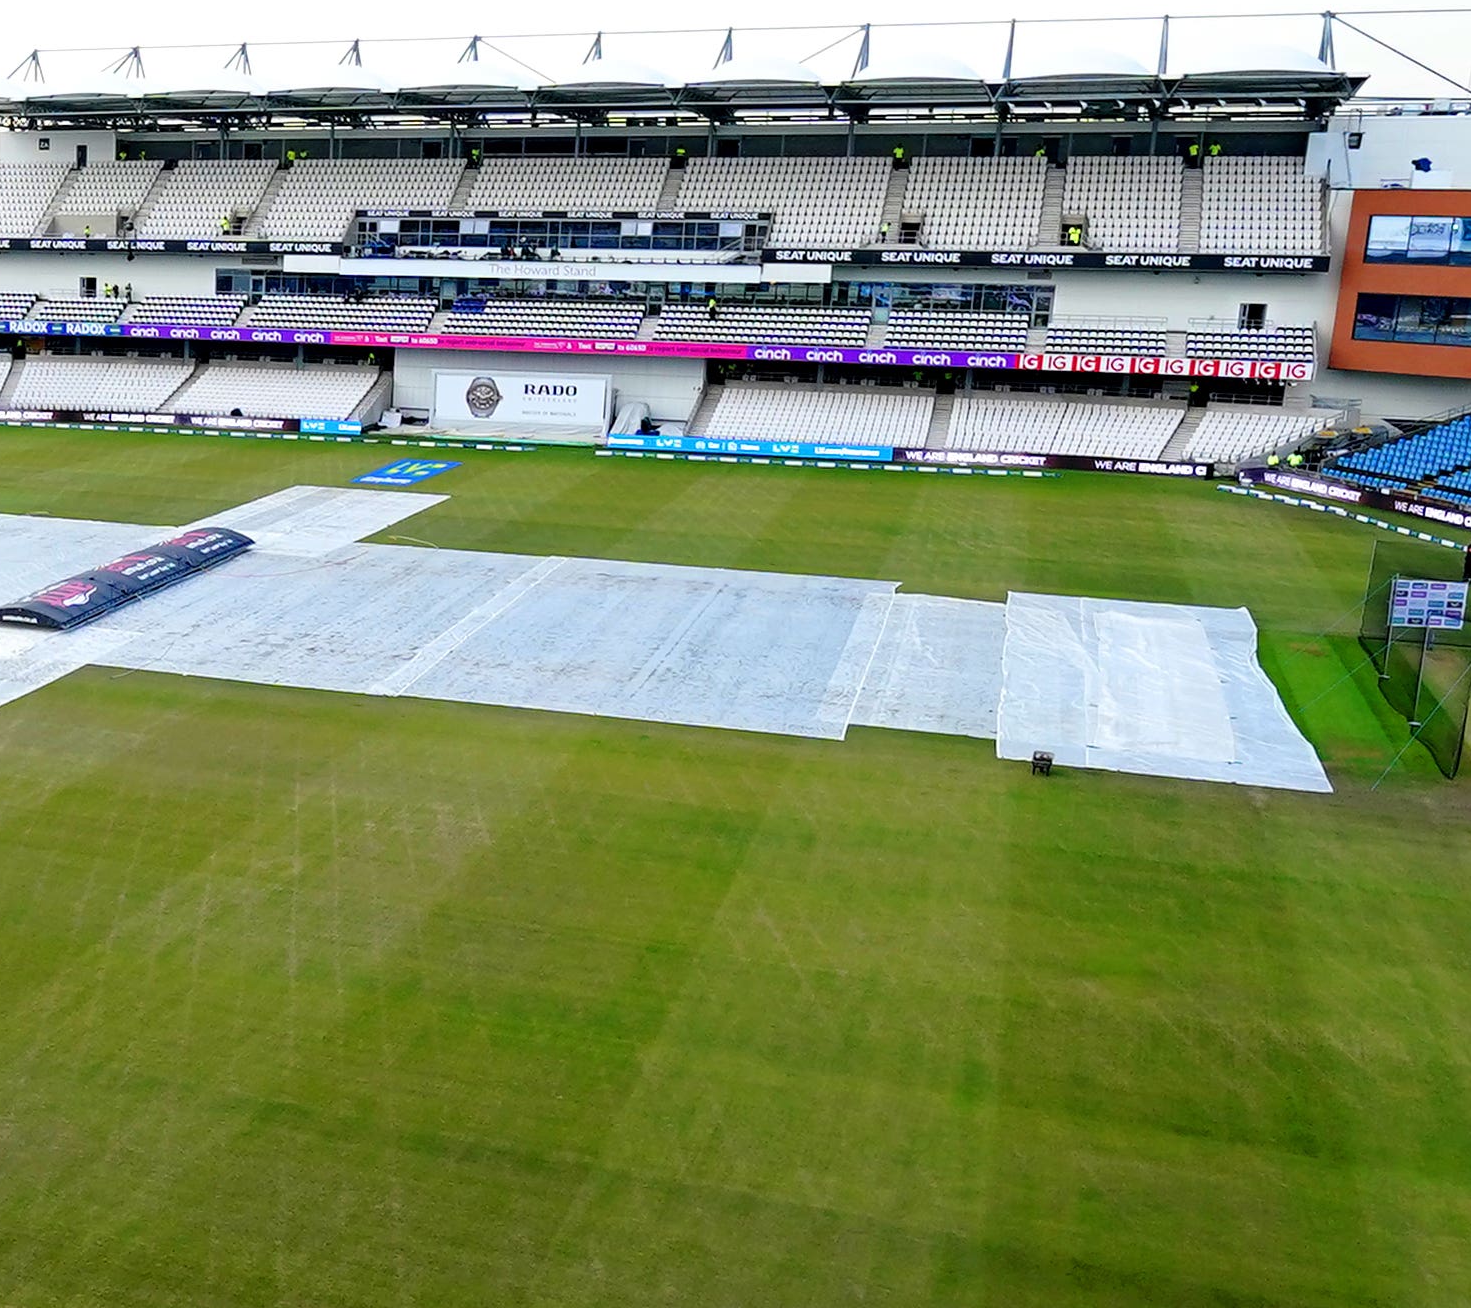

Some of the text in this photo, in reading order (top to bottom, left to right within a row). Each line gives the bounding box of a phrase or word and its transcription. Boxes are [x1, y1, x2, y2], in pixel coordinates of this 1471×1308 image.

[30, 240, 86, 249] SEAT UNIQUE
[270, 243, 332, 253] SEAT UNIQUE
[775, 250, 852, 262] SEAT UNIQUE
[881, 251, 961, 263] SEAT UNIQUE
[1106, 255, 1191, 268] SEAT UNIQUE
[1224, 257, 1313, 269] SEAT UNIQUE
[490, 264, 596, 277] The Howard Stand
[9, 320, 48, 334] RADOX
[66, 322, 106, 337] RADOX
[130, 326, 159, 337] cinch
[210, 329, 240, 340] cinch
[754, 348, 791, 360] cinch
[806, 349, 843, 362] cinch
[858, 352, 897, 365] cinch
[967, 355, 1006, 367] cinch
[1019, 354, 1042, 369] IG
[1048, 356, 1066, 370] IG
[1106, 358, 1125, 372] IG
[1165, 359, 1184, 374] IG
[1225, 361, 1244, 376] IG
[1287, 363, 1306, 379] IG
[523, 384, 578, 397] RADO
[905, 451, 1046, 467] WE ARE ENGLAND CRICKET
[1394, 500, 1409, 513] WE
[1408, 503, 1425, 517] ARE
[1425, 507, 1465, 527] ENGLAND
